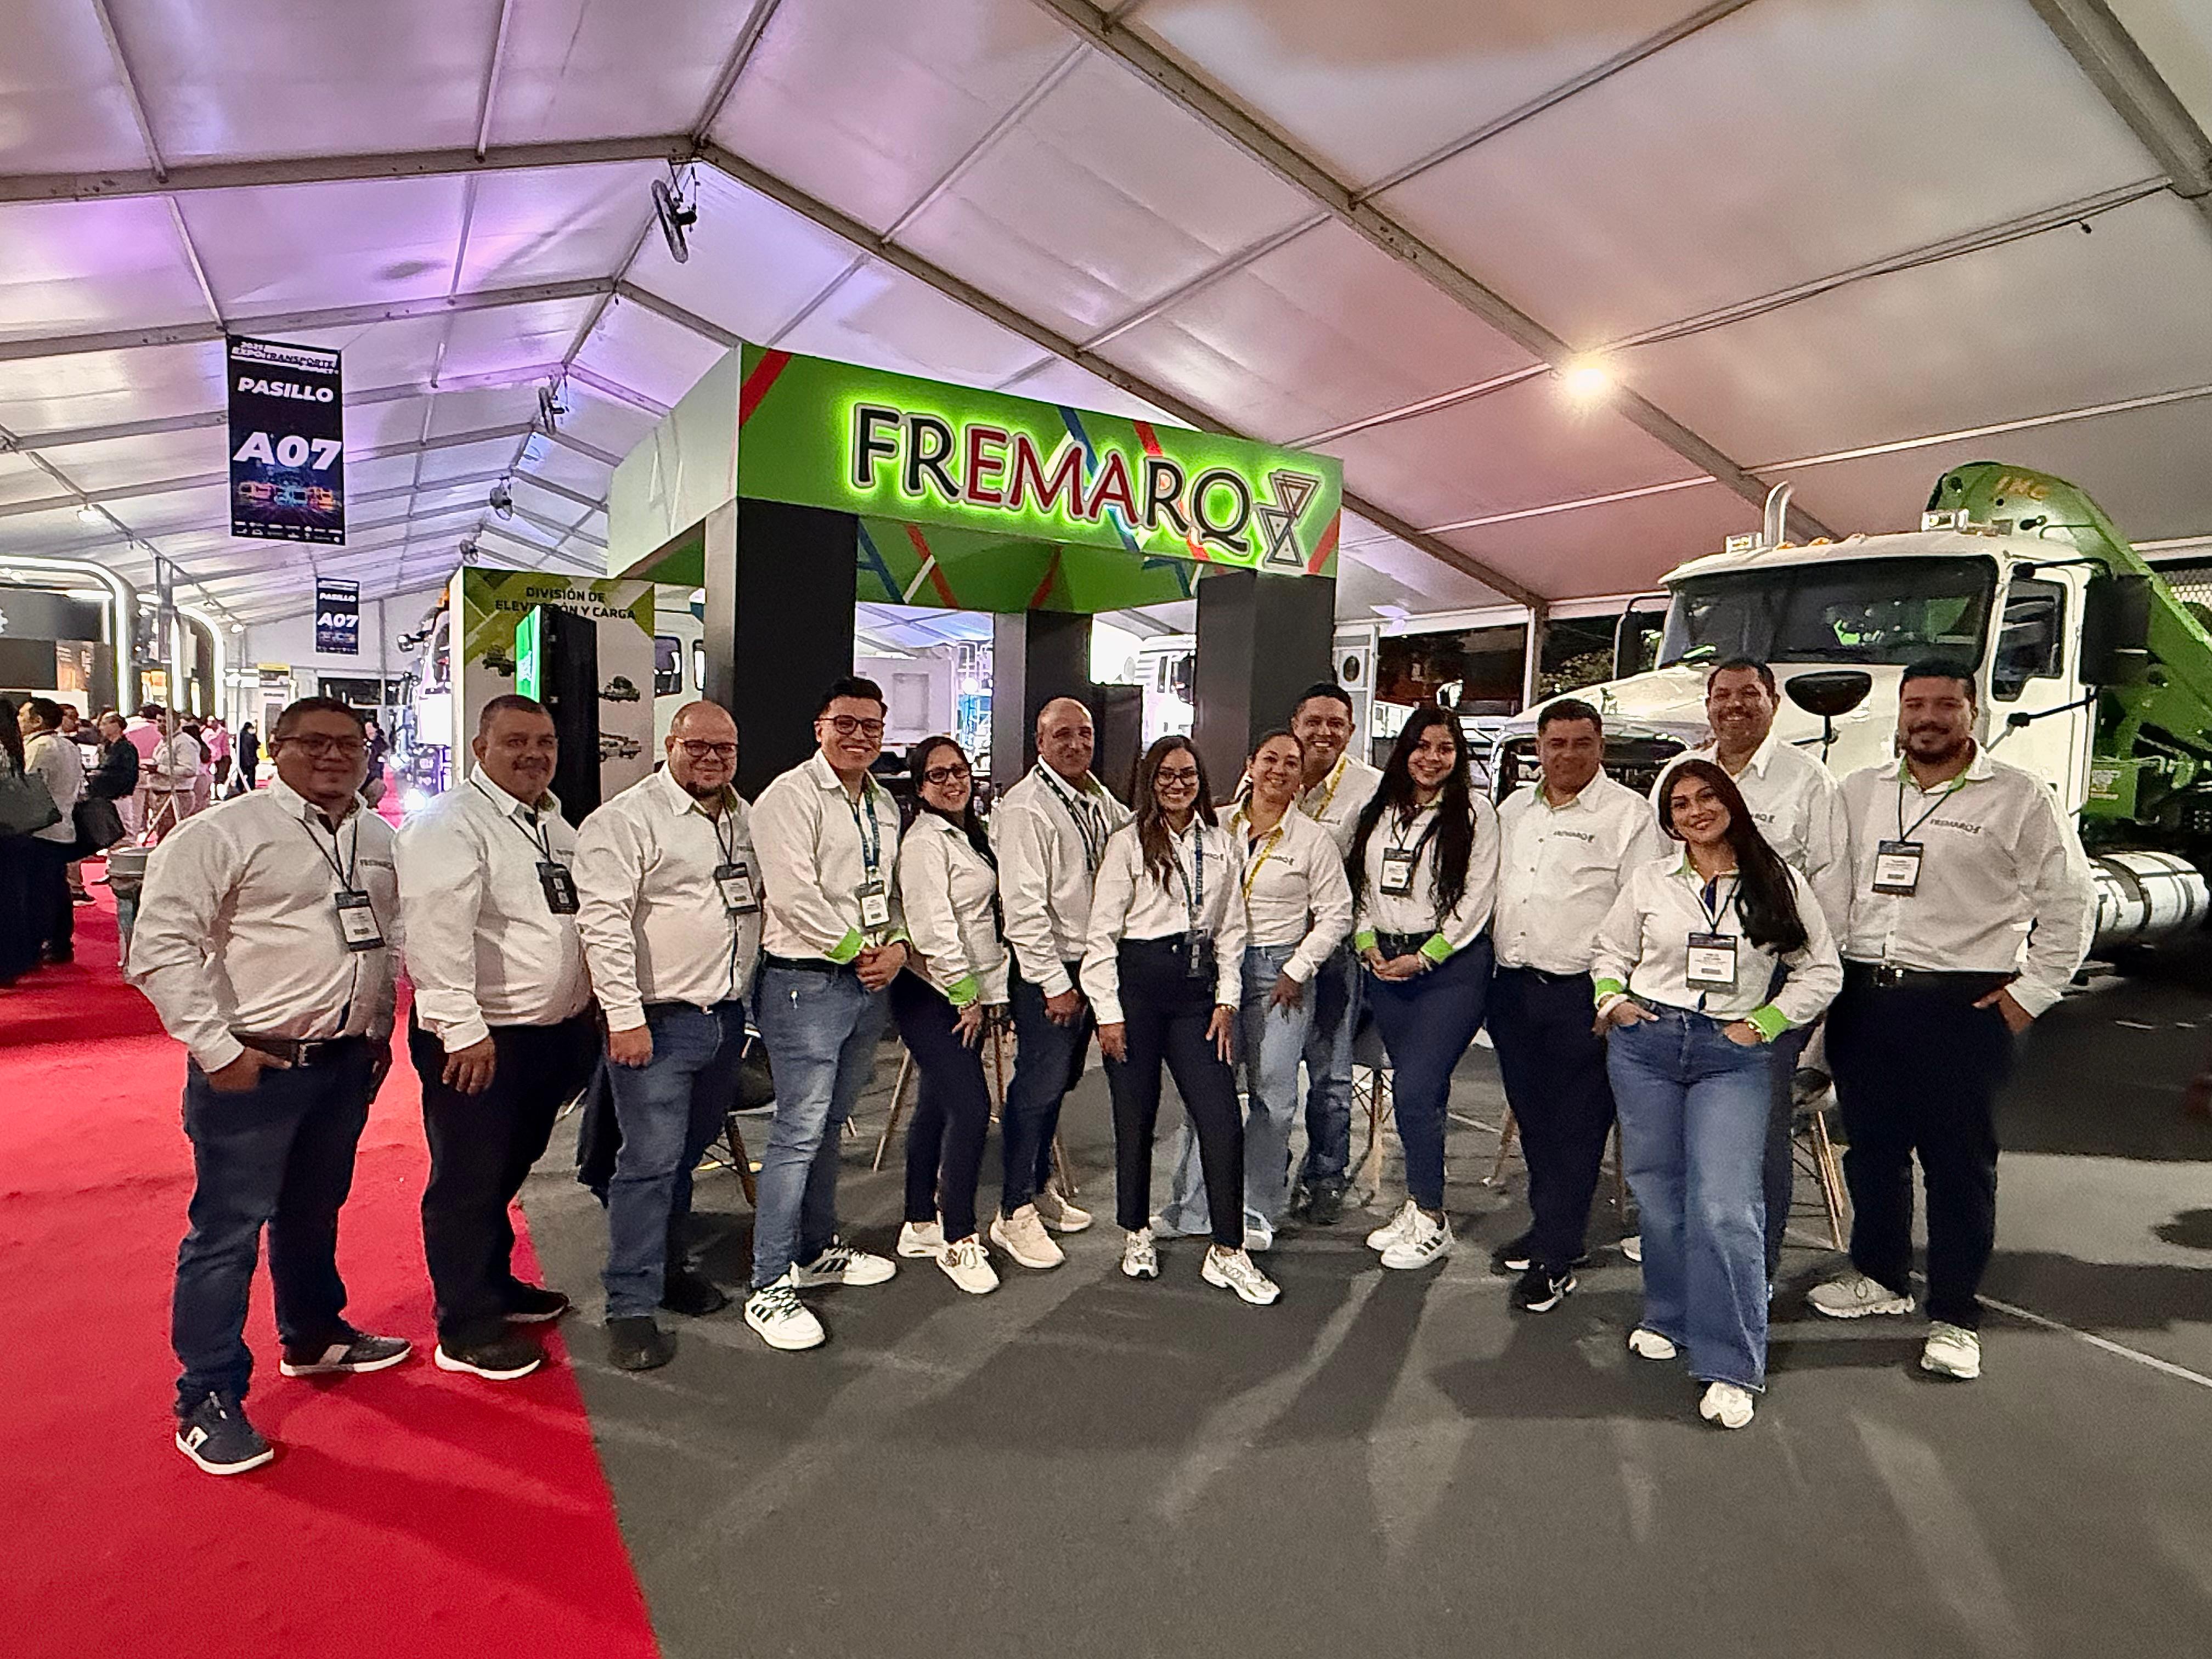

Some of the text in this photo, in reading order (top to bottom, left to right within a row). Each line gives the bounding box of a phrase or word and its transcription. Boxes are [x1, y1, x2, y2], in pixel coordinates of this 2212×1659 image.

[237, 377, 334, 403] PASILLO
[233, 431, 342, 471] A07
[852, 403, 1250, 556] FREMARQ
[526, 587, 605, 603] DIVISIÓN DE
[318, 612, 358, 628] A07
[581, 606, 590, 617] Y
[592, 607, 636, 620] CARGA
